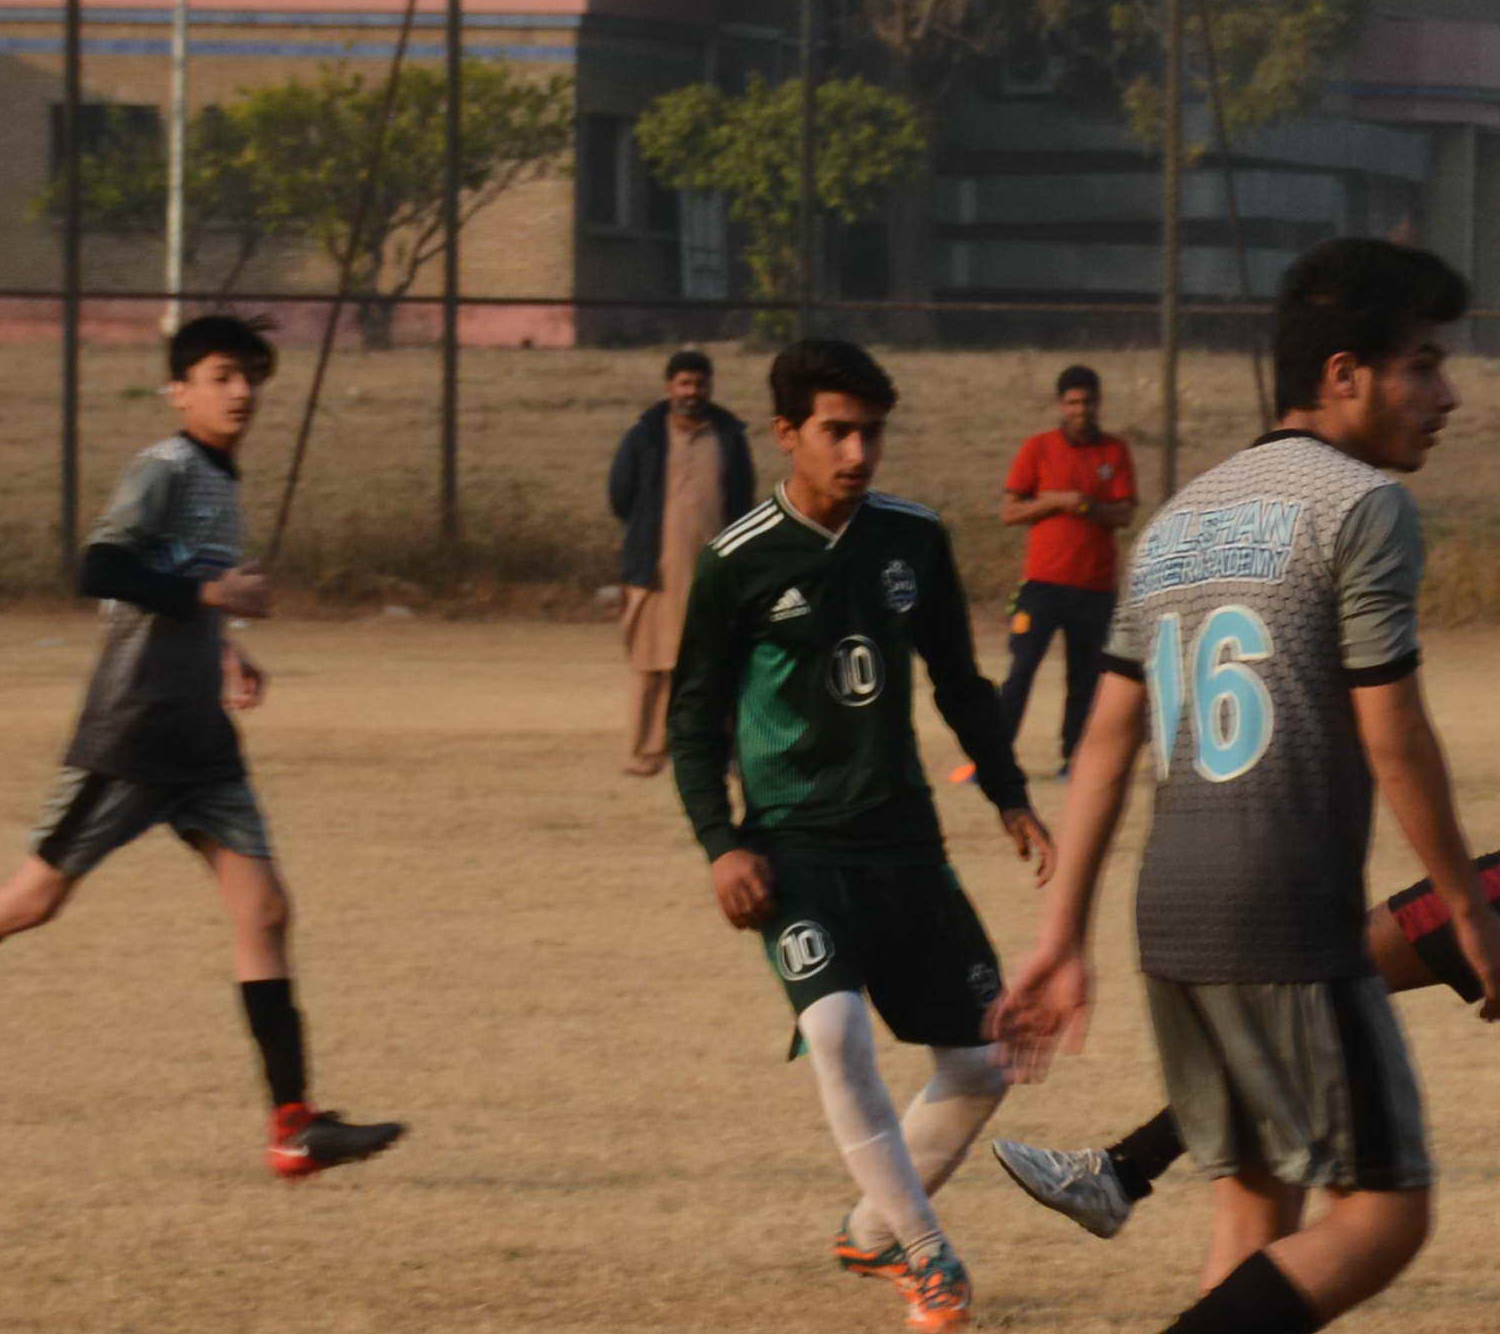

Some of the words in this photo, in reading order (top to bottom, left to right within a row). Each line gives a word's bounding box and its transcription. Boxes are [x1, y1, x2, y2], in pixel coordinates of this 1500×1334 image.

[1196, 546, 1290, 582] ACADEMY
[834, 645, 877, 695] 10
[1147, 604, 1274, 783] 16
[781, 928, 826, 973] 10
